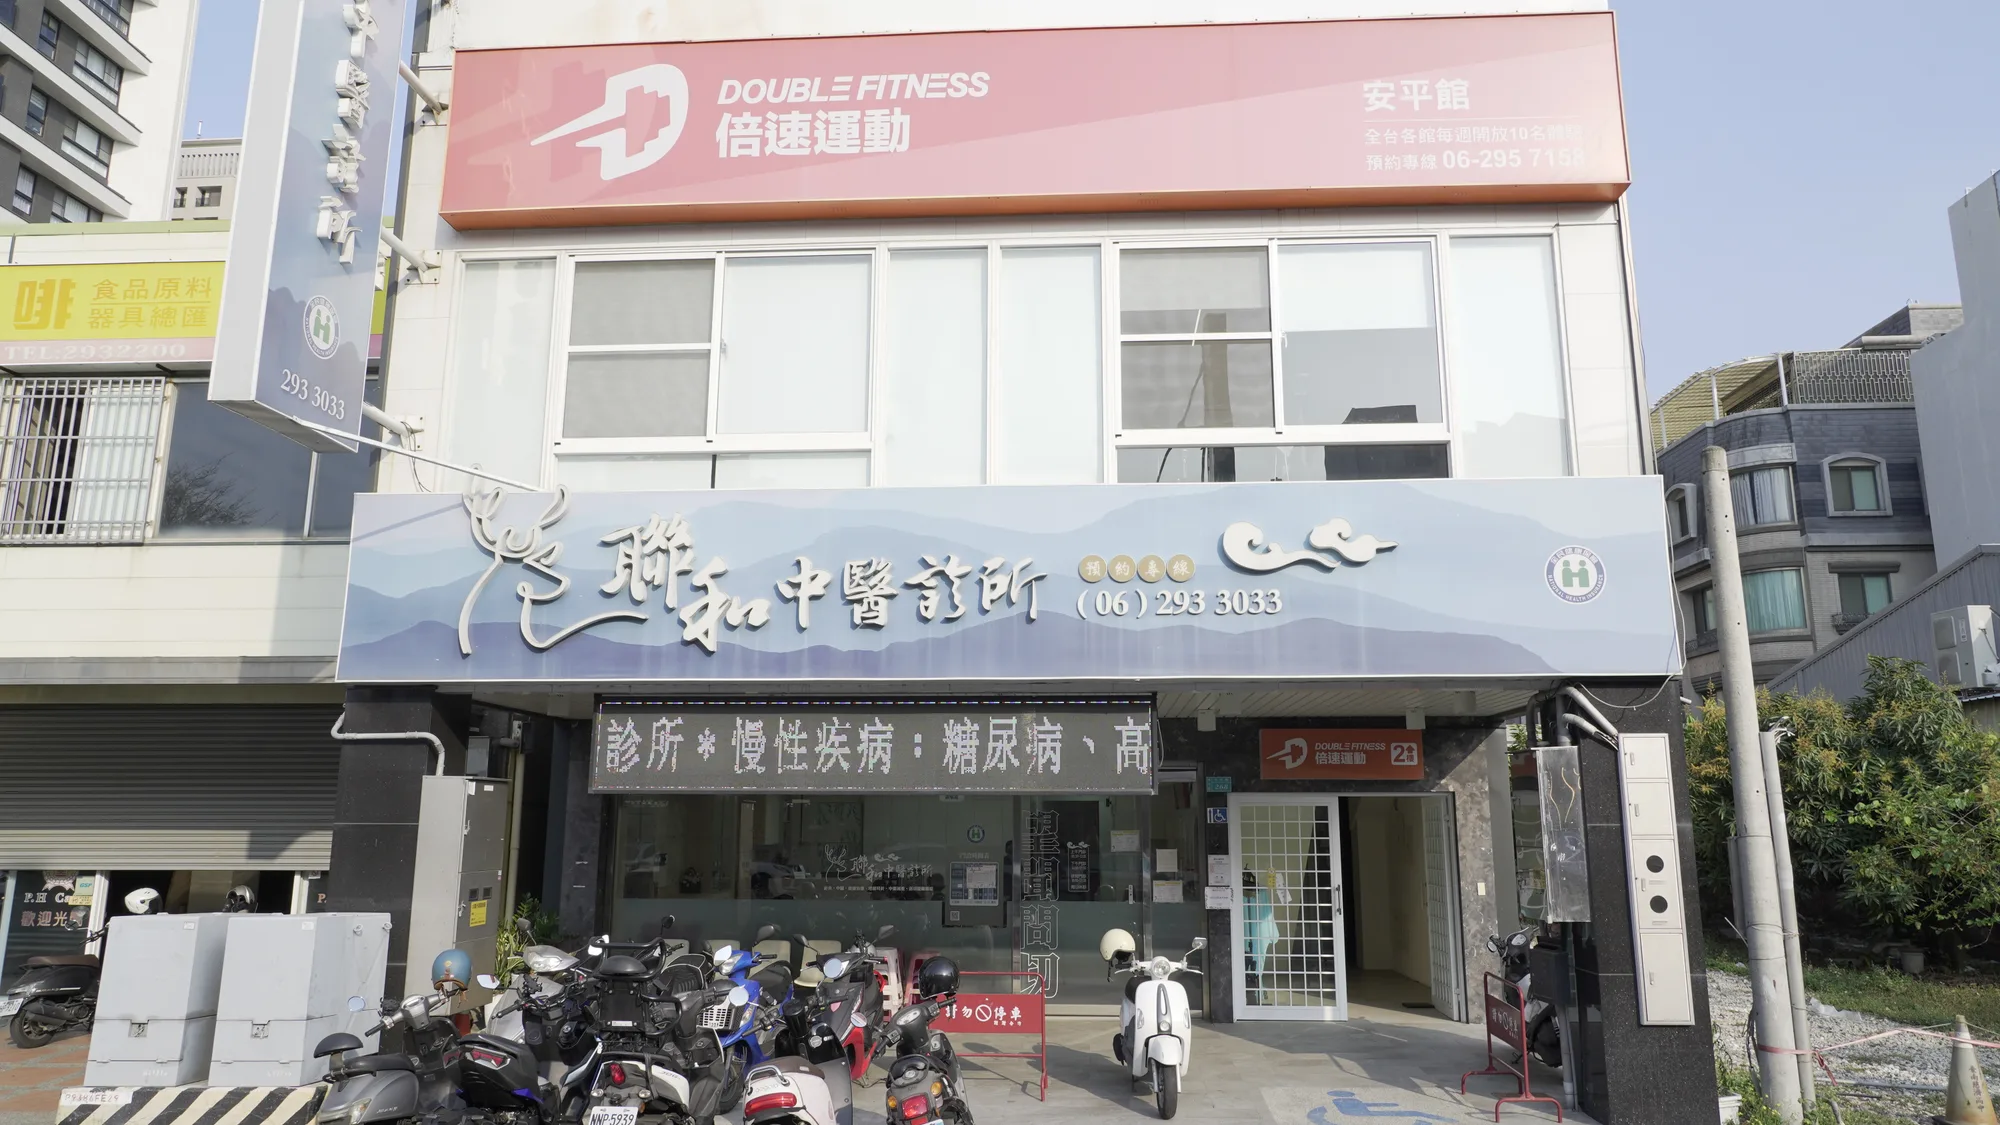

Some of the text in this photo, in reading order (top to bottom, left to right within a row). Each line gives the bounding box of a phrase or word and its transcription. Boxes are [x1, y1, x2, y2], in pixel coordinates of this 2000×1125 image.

[717, 72, 990, 104] DOUBLE FITNESS
[1363, 79, 1470, 112] 安平館
[716, 107, 910, 158] 倍速運動
[1365, 147, 1585, 171] 預約專線 06-295 7158
[92, 276, 212, 301] 食品原料
[87, 305, 211, 329] 器具總匯
[280, 368, 345, 420] 293 3033
[1086, 559, 1190, 577] 預約專線
[600, 512, 1048, 652] 聯和中醫診所
[1155, 589, 1206, 615] 293
[1214, 588, 1283, 615] 3033
[1314, 742, 1386, 750] DOUBLE FITNESS
[1315, 751, 1366, 765] 倍速運動
